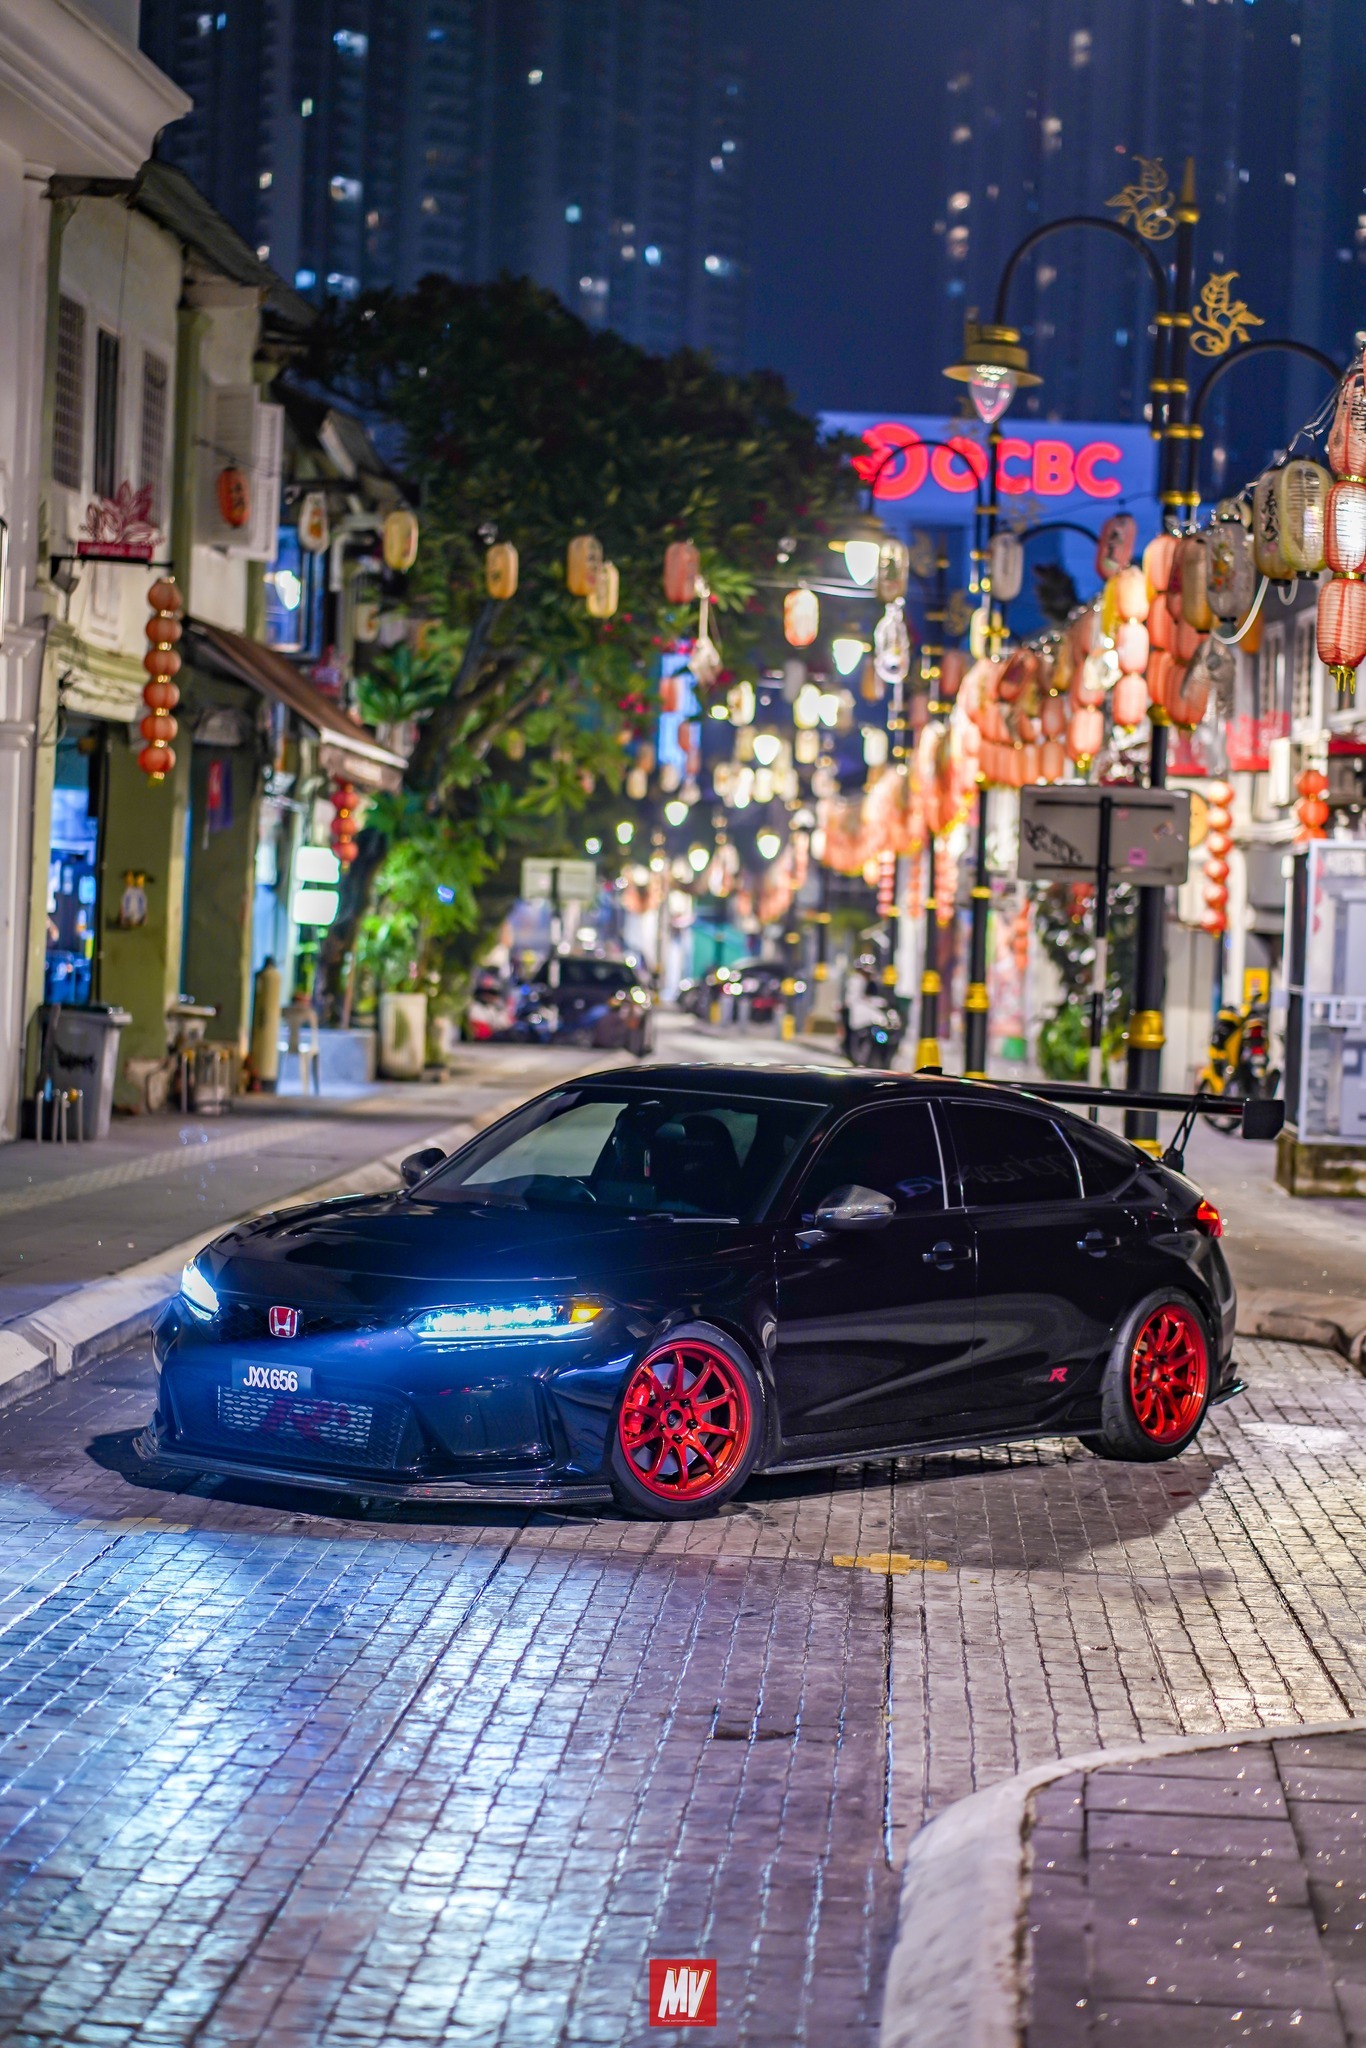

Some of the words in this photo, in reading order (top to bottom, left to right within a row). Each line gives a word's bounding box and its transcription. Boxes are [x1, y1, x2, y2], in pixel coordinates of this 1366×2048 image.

[931, 436, 1123, 498] OCBC
[243, 1366, 298, 1392] JXX656
[1048, 1367, 1068, 1382] R
